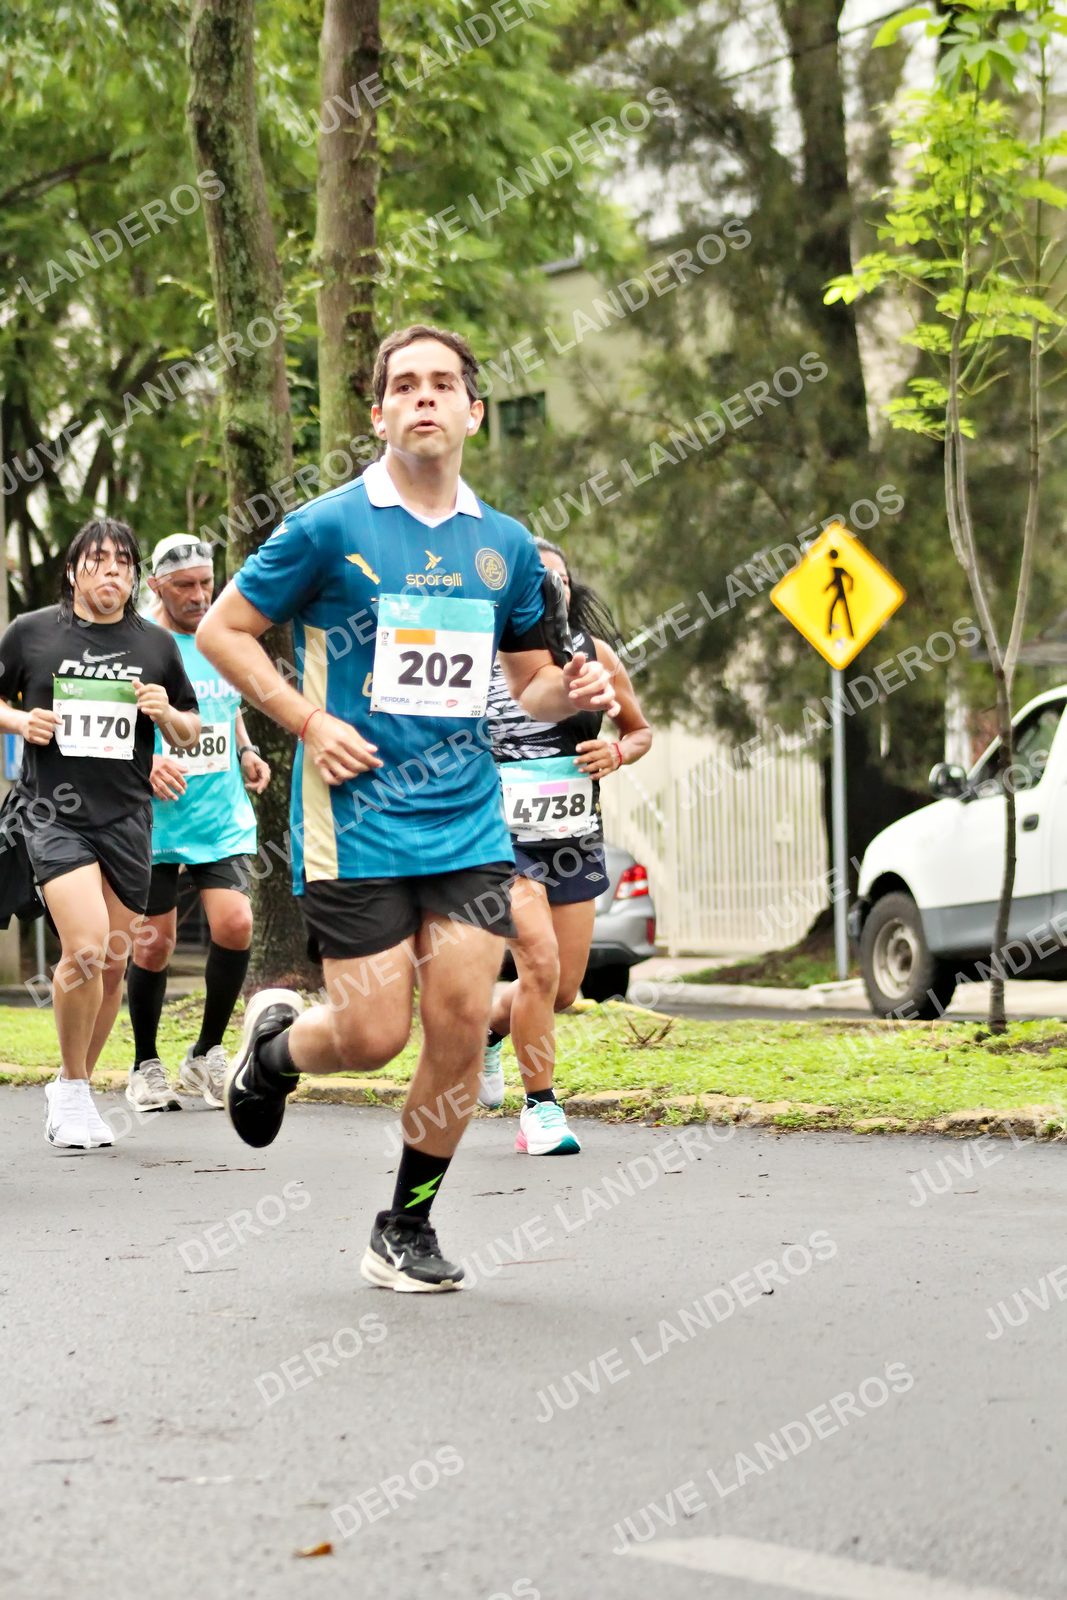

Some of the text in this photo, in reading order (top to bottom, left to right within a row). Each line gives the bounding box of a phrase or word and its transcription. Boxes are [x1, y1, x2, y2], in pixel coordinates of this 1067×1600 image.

[405, 573, 463, 588] sporelli
[397, 650, 474, 689] 202
[61, 714, 131, 740] 1170
[512, 793, 586, 823] 4738
